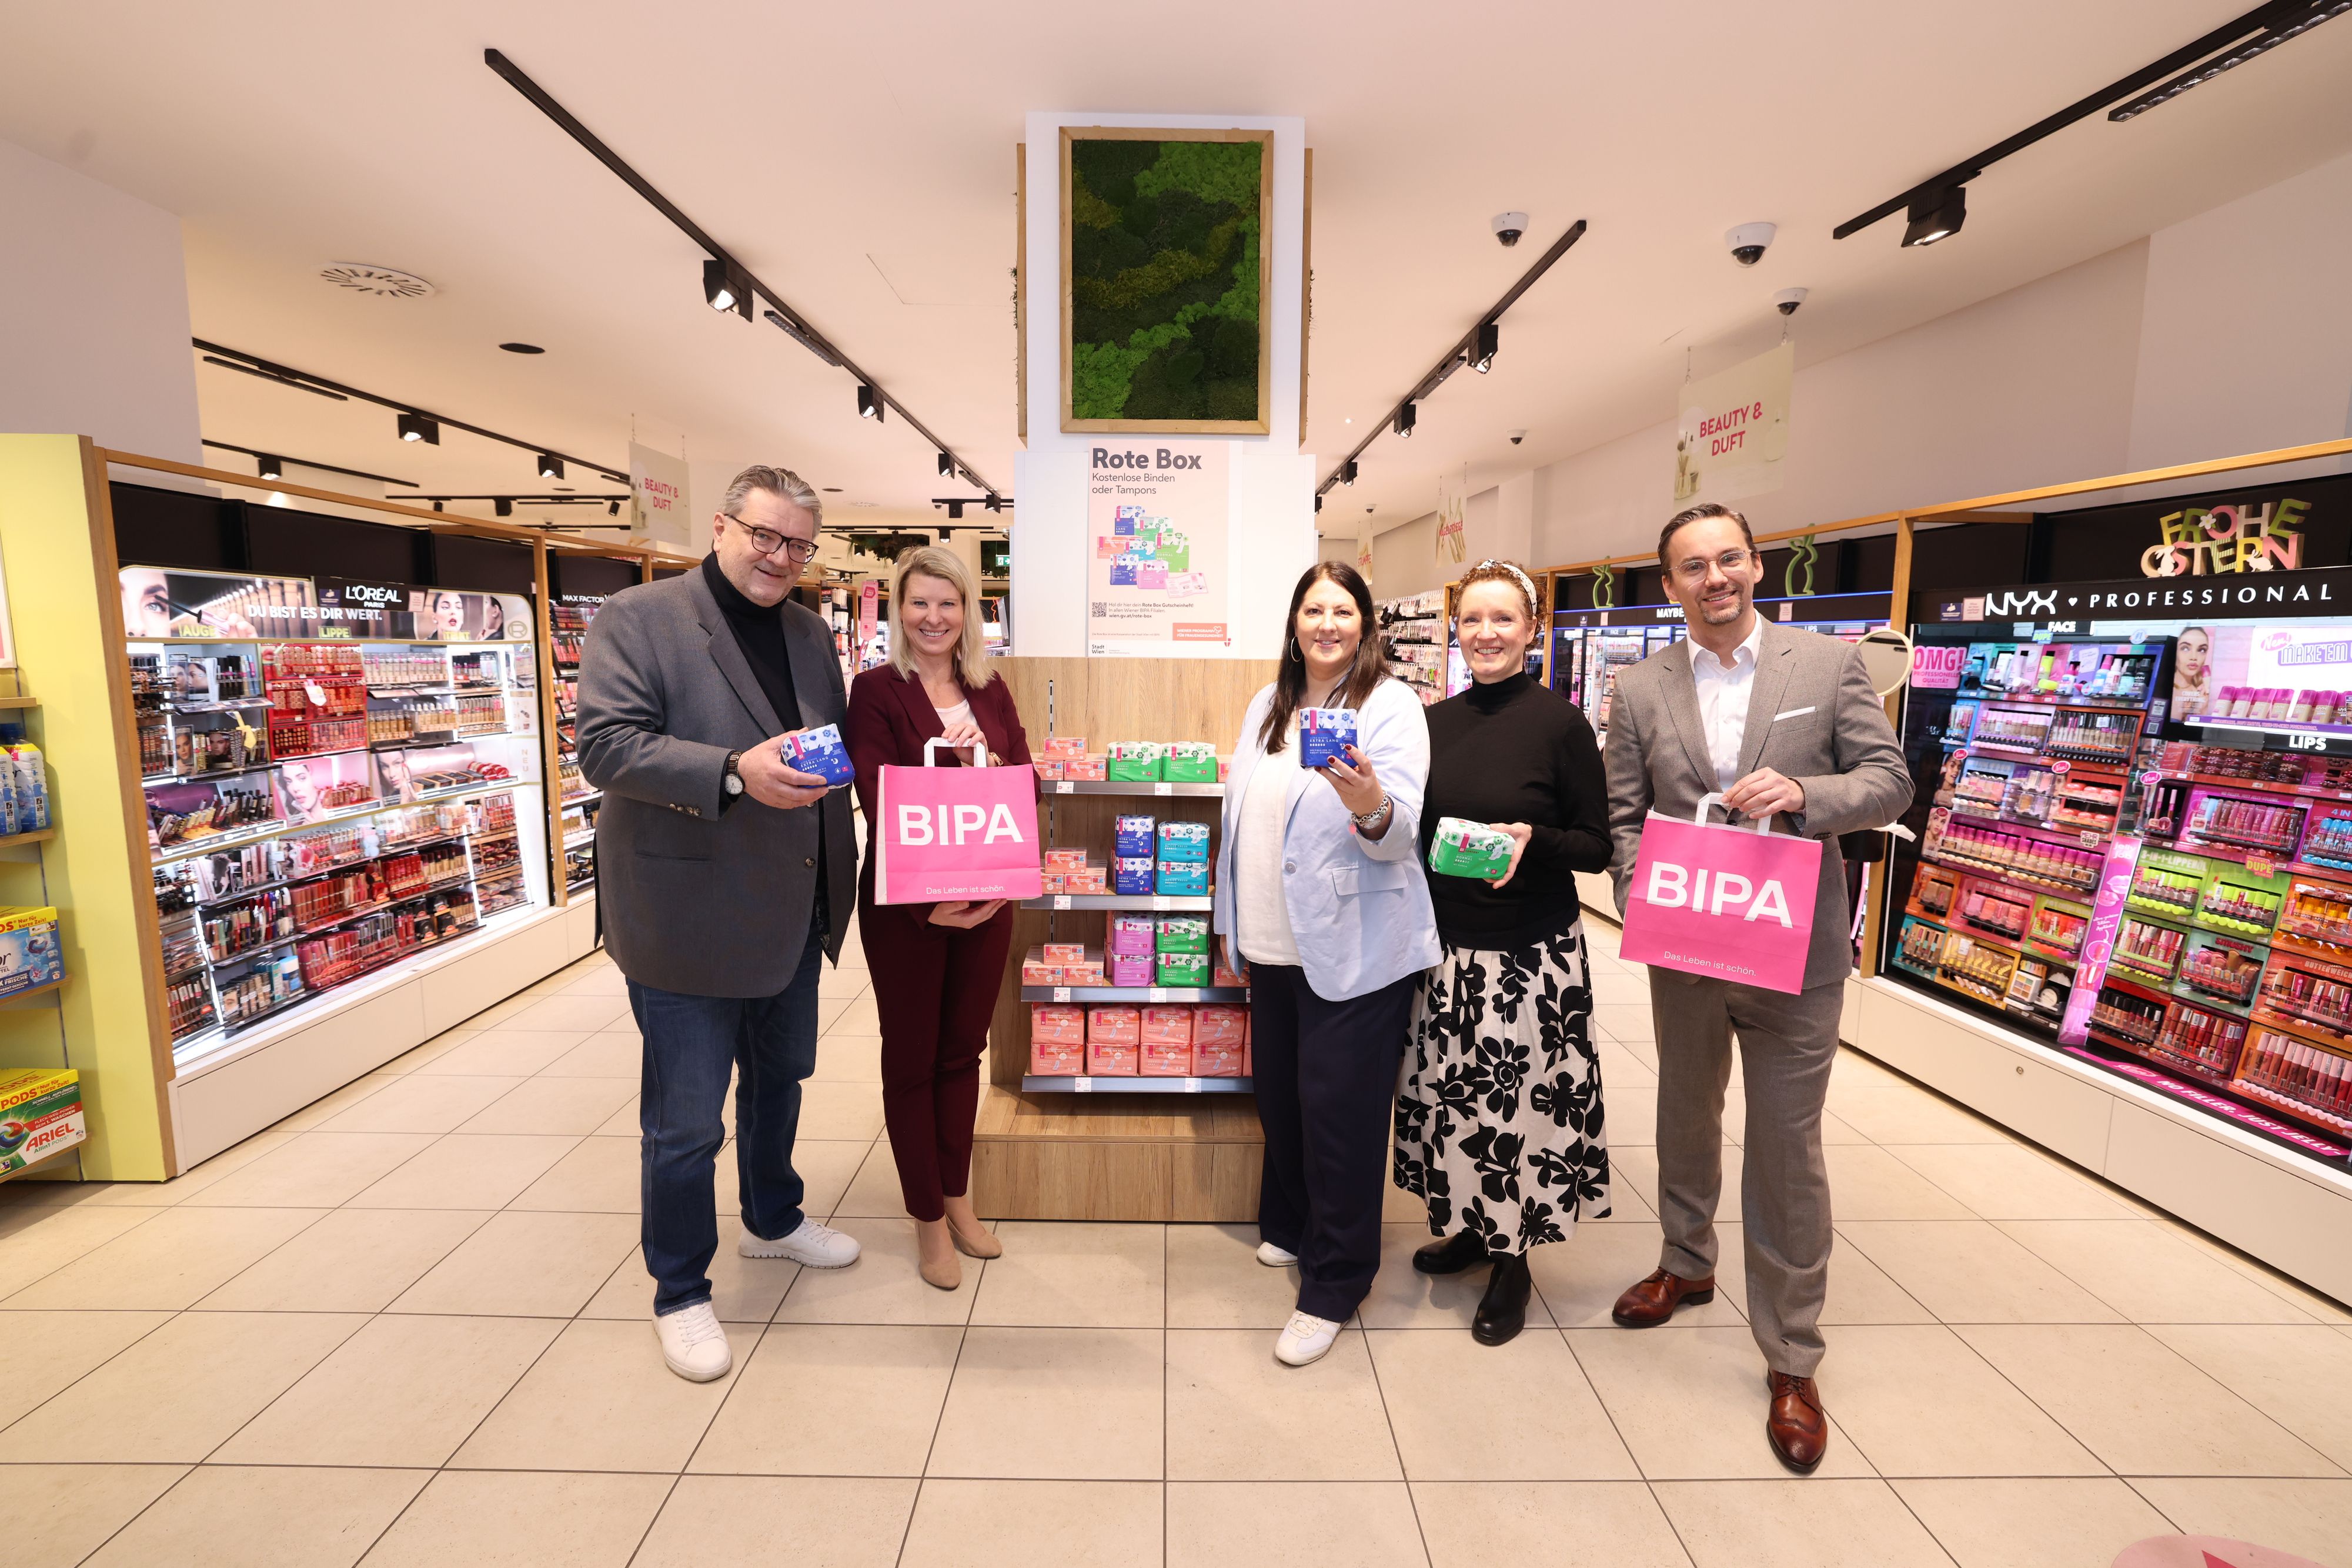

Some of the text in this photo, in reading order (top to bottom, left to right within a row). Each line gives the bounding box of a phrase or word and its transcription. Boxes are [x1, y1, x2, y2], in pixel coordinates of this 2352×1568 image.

[1700, 402, 1763, 438] BEAUTY &
[1712, 430, 1746, 456] DUFT
[1093, 448, 1202, 469] Rote Box
[644, 477, 679, 498] BEAUTY &
[1093, 473, 1175, 482] Kostenlose Binden
[1092, 485, 1157, 496] oder Tampons
[653, 496, 671, 511] DUFT
[2160, 499, 2312, 546] FROHE
[346, 585, 402, 603] L'ORÉAL
[1985, 590, 2057, 616] NYX
[2089, 584, 2333, 608] PROFESSIONAL
[248, 604, 383, 621] DU BIST ES DIR WERT.
[2048, 621, 2076, 633] FACE
[1913, 648, 1964, 671] OMG!
[2281, 642, 2348, 664] MAKE'EM
[2289, 735, 2327, 751] LIPS
[898, 804, 1024, 845] BIPA
[2246, 860, 2273, 874] DUPE
[926, 887, 941, 895] Das
[944, 886, 968, 894] Leben
[980, 885, 1005, 893] schön.
[1646, 861, 1793, 928] BIPA
[1663, 951, 1756, 977] Das Leben ist schön.
[5, 975, 28, 985] FRISCHE
[32, 1095, 51, 1105] SCHNELL
[2157, 1080, 2184, 1090] NO
[2238, 1114, 2284, 1132] JUST
[35, 1105, 75, 1125] FLECK-WEG-POWER
[51, 1109, 75, 1122] WASCHEN
[26, 1123, 75, 1152] ARIEL
